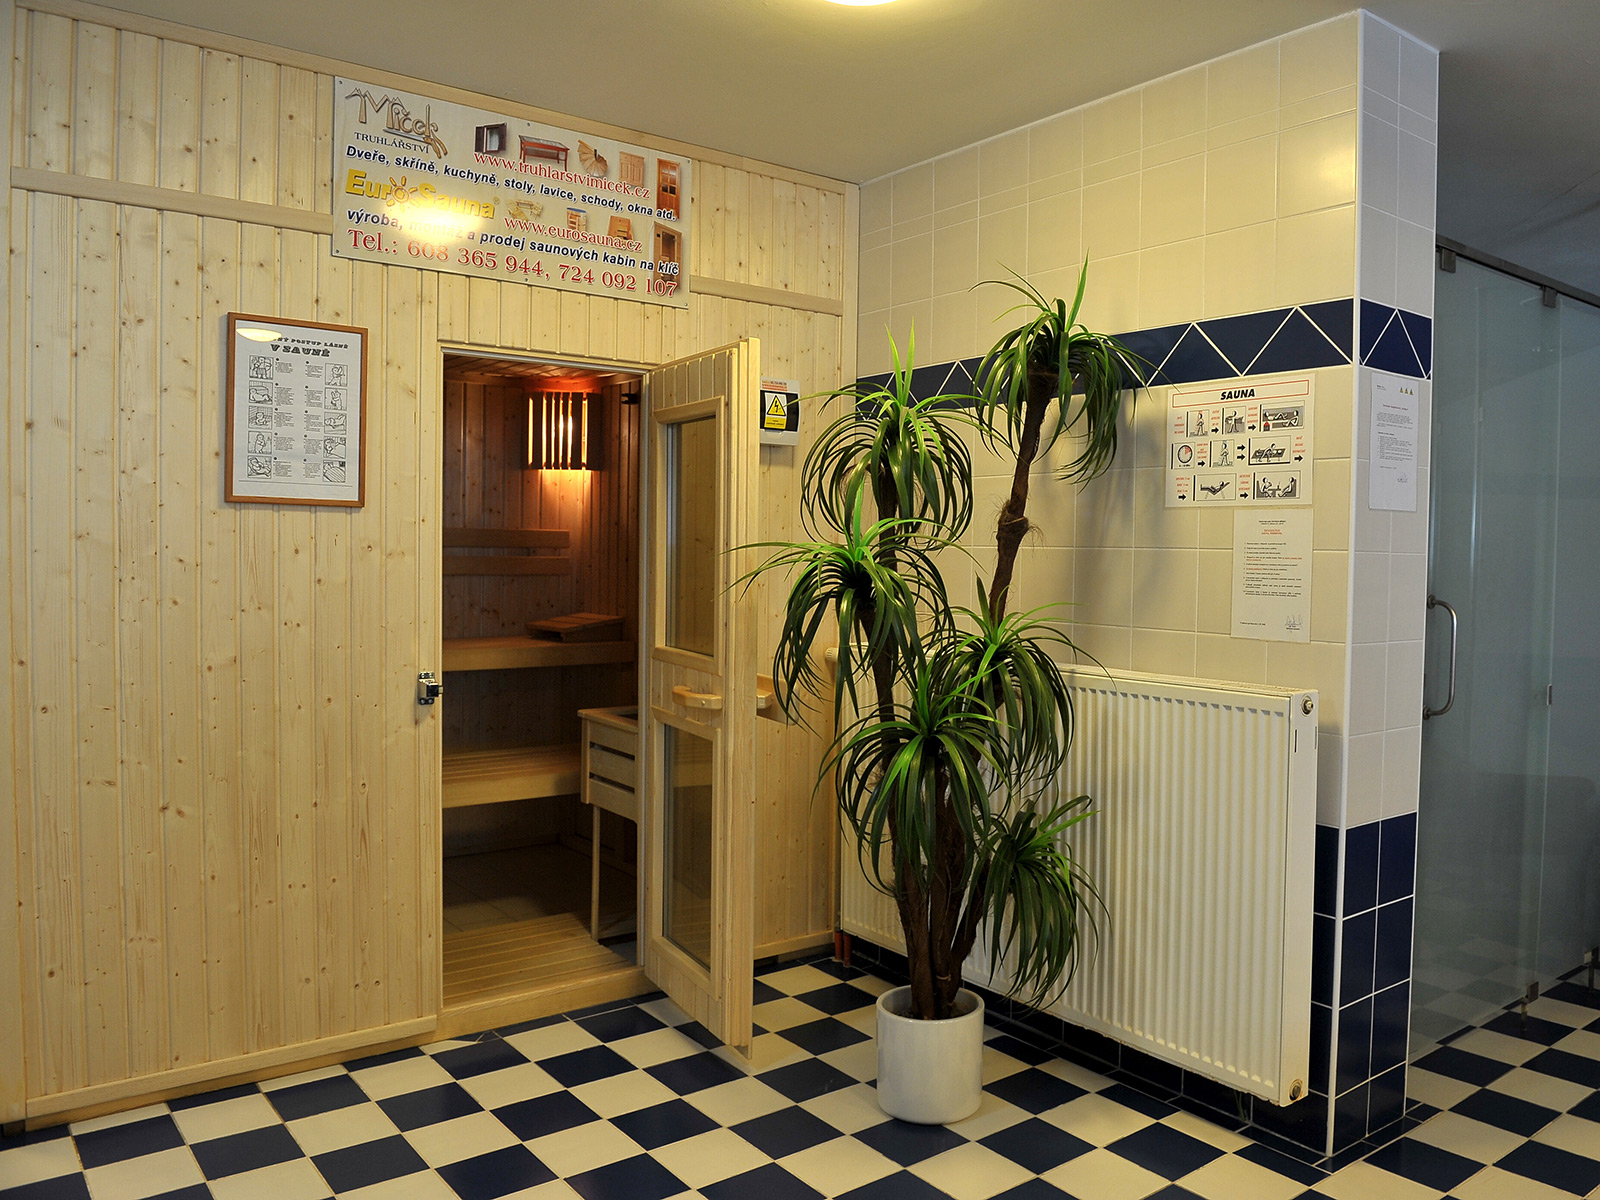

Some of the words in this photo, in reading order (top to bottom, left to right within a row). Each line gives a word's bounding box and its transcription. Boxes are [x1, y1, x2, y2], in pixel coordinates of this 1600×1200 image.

[354, 131, 430, 154] TRUHLÁŘSTVÍ
[346, 145, 390, 166] Dveře,
[394, 154, 439, 175] skříně,
[444, 164, 500, 187] kuchyně,
[504, 178, 536, 194] stoly,
[540, 184, 577, 202] lavice,
[580, 193, 624, 213] schody,
[627, 202, 654, 216] okna
[656, 208, 677, 221] atd.
[474, 152, 651, 199] www.truhlarstvimicek.cz
[347, 208, 403, 231] výroba,
[467, 231, 476, 241] a
[480, 232, 526, 252] prodej
[529, 240, 598, 261] saunových
[602, 251, 636, 268] kabin
[640, 260, 654, 271] na
[658, 261, 679, 275] klíč
[504, 217, 642, 252] www.eurosauna.cz
[347, 229, 397, 254] Tel.:
[407, 239, 449, 262] 608
[457, 247, 497, 270] 365
[505, 255, 550, 280] 944,
[558, 263, 595, 284] 724
[602, 271, 636, 291] 092
[646, 278, 677, 297] 107
[270, 343, 280, 352] V
[1220, 388, 1256, 401] SAUNA
